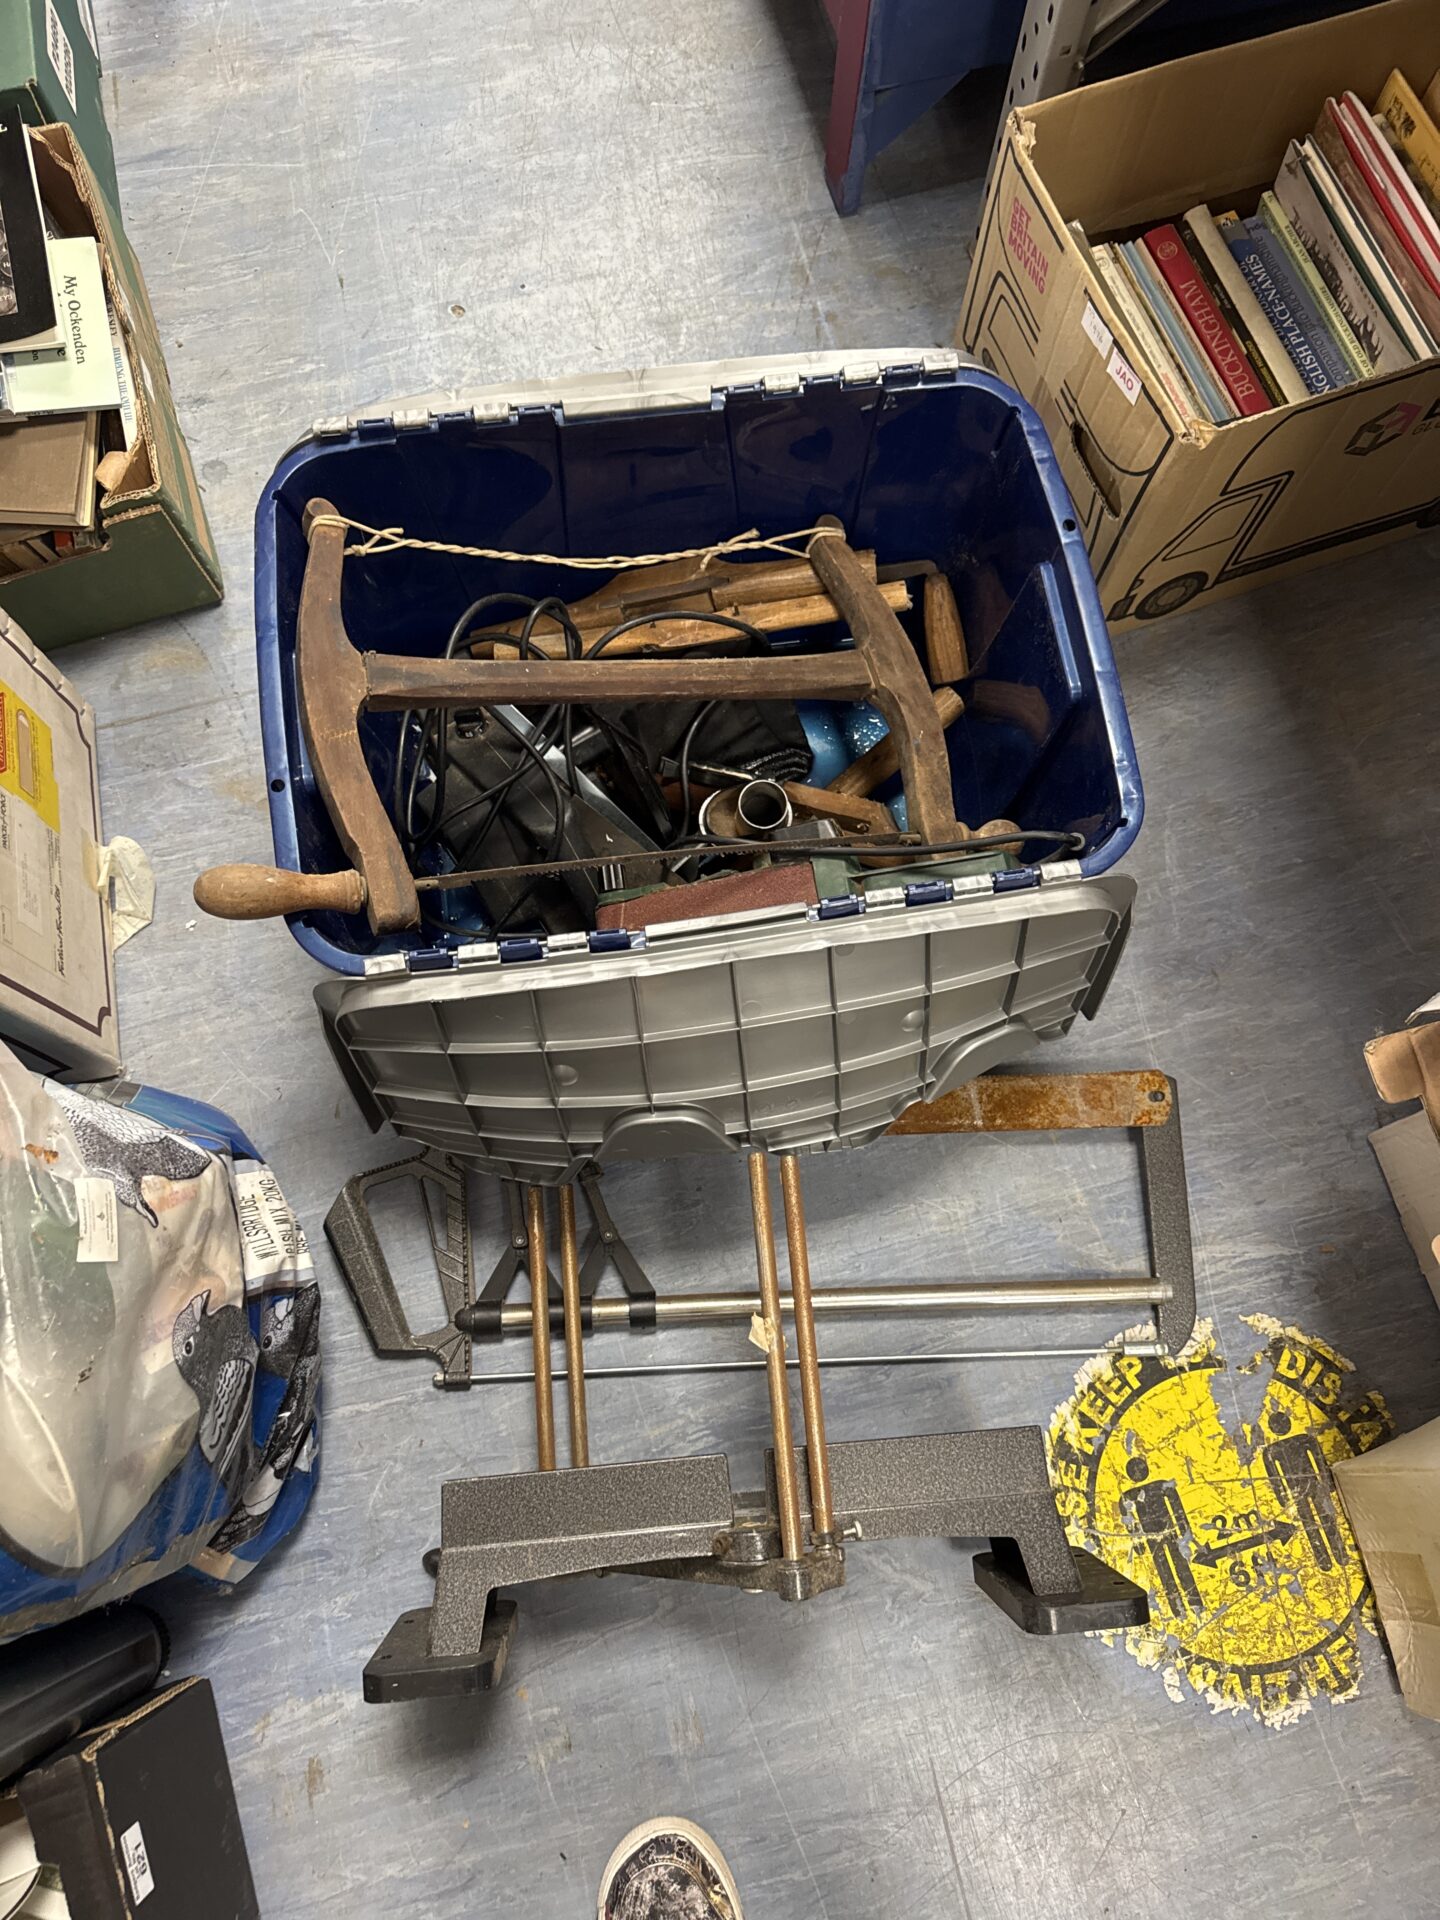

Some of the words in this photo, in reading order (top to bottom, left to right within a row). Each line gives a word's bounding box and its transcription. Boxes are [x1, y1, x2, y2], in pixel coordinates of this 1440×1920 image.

[1014, 196, 1031, 229] GET
[1008, 230, 1043, 294] MOVING
[1011, 213, 1049, 277] BRITAIN
[63, 275, 76, 295] My
[1244, 251, 1304, 345] PLACE-NAMES
[67, 299, 87, 364] Ockenden
[1178, 277, 1256, 399] BUCKINGHAM
[259, 1179, 282, 1201] 20KG
[241, 1194, 279, 1259] WILLSBRIDGE
[269, 1206, 289, 1224] MIX
[1210, 1509, 1260, 1540] 2m
[135, 1841, 148, 1875] 621
